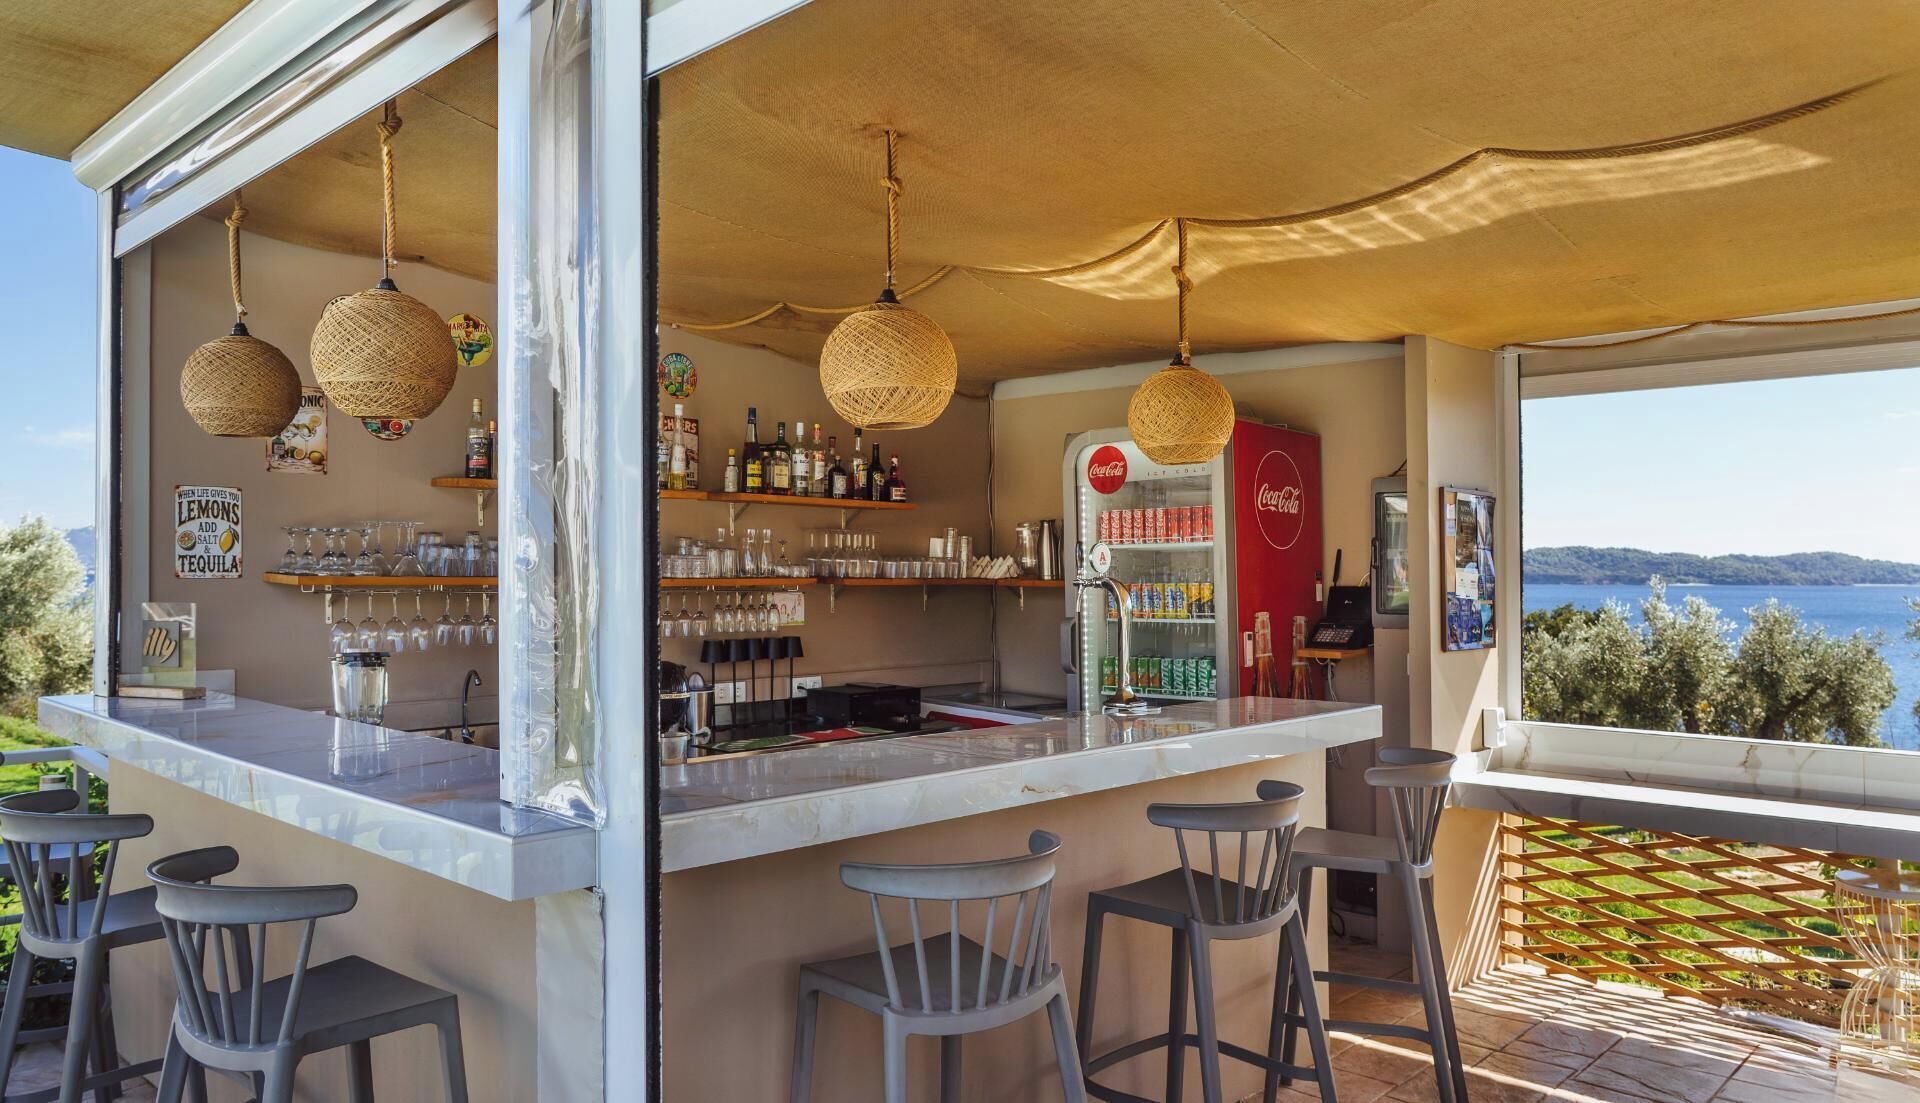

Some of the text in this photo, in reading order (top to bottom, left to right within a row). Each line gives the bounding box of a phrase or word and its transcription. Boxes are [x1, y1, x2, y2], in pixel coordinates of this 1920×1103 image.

[300, 395, 324, 408] ONIC
[663, 418, 697, 434] CHRS
[1089, 461, 1125, 478] Coca-Cola
[178, 488, 240, 503] WHEN LIFE GIVES YOU
[1258, 483, 1300, 514] Coca-Cola
[178, 500, 240, 527] LEMONS
[198, 521, 217, 533] ADD
[197, 534, 219, 545] SALT
[204, 545, 211, 554] &
[178, 554, 239, 574] TEQUILA
[143, 627, 177, 664] illy
